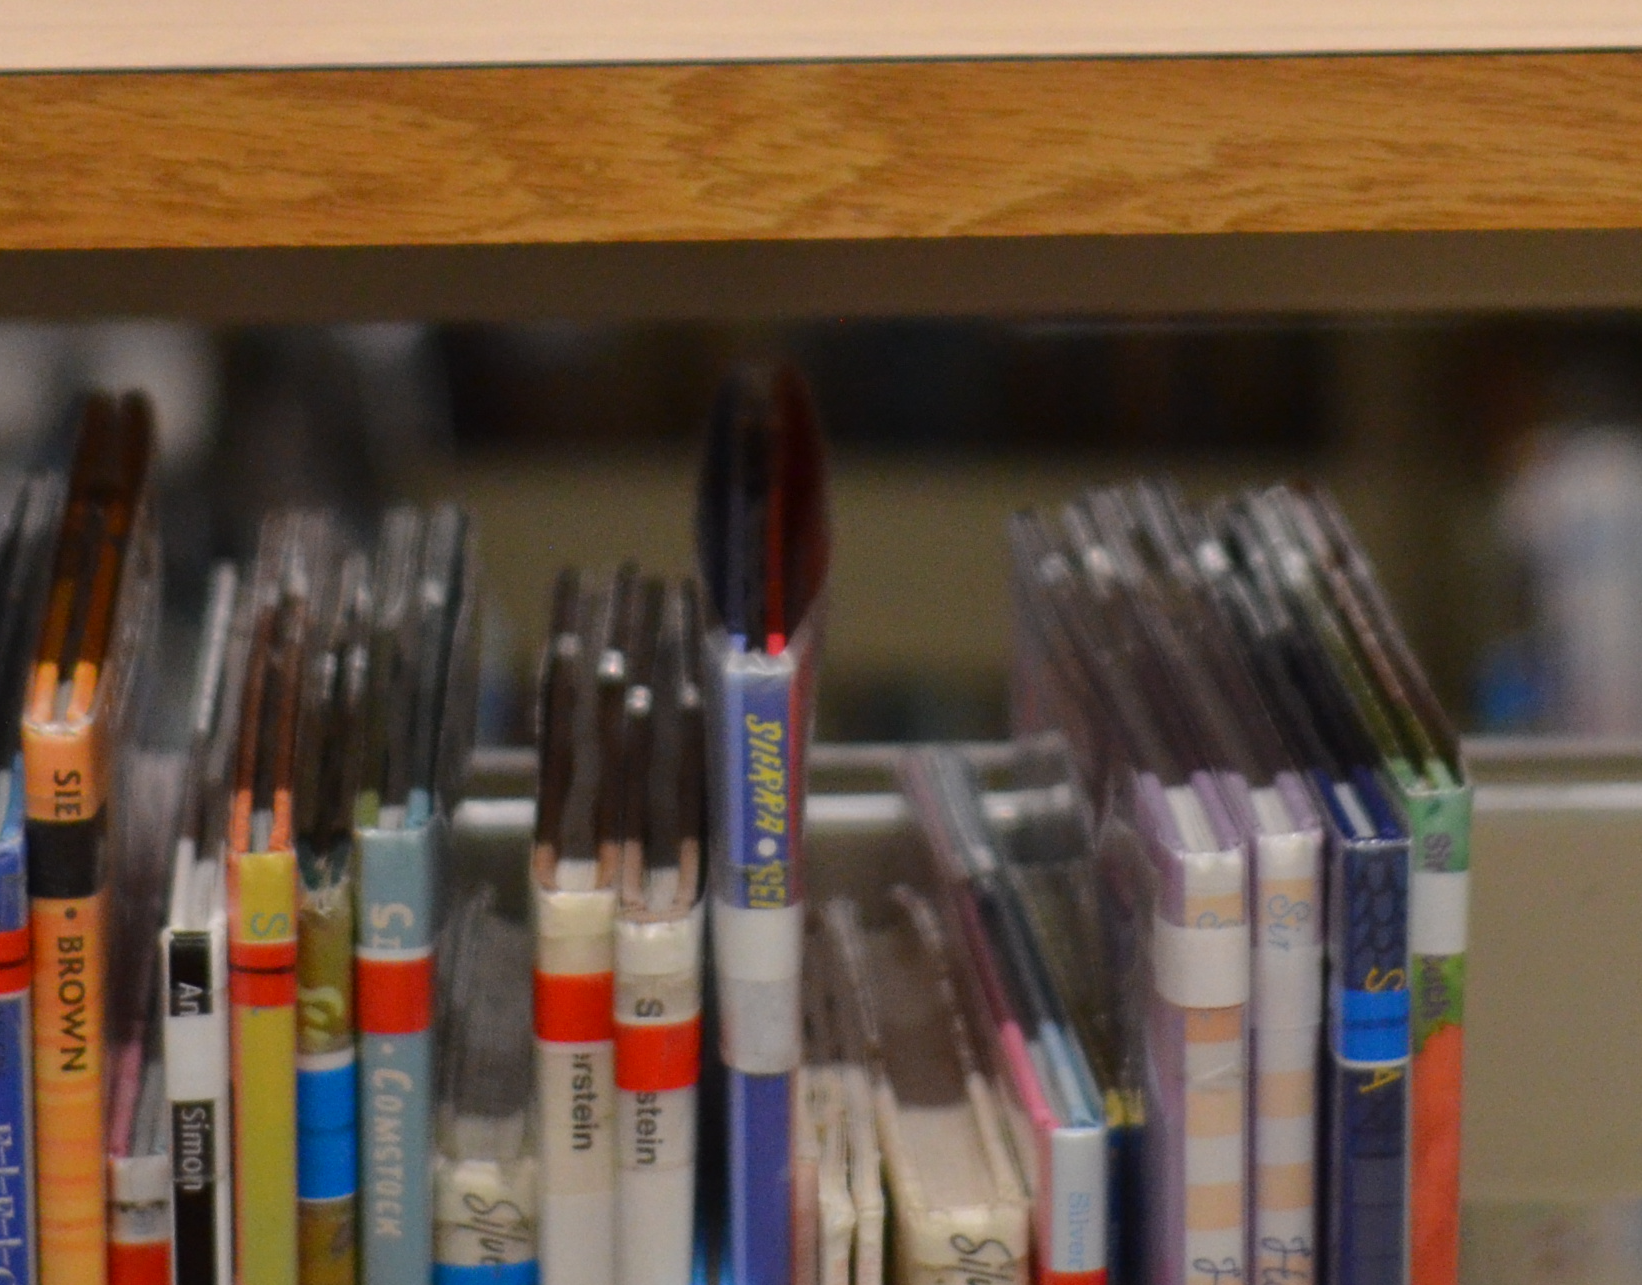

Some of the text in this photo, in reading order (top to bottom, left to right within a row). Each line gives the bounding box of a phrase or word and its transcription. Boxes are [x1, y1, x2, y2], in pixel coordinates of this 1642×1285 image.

[745, 713, 788, 834] SIERRA
[57, 935, 88, 1072] BROWN
[181, 1107, 210, 1192] Simon
[1068, 1192, 1091, 1272] Silver
